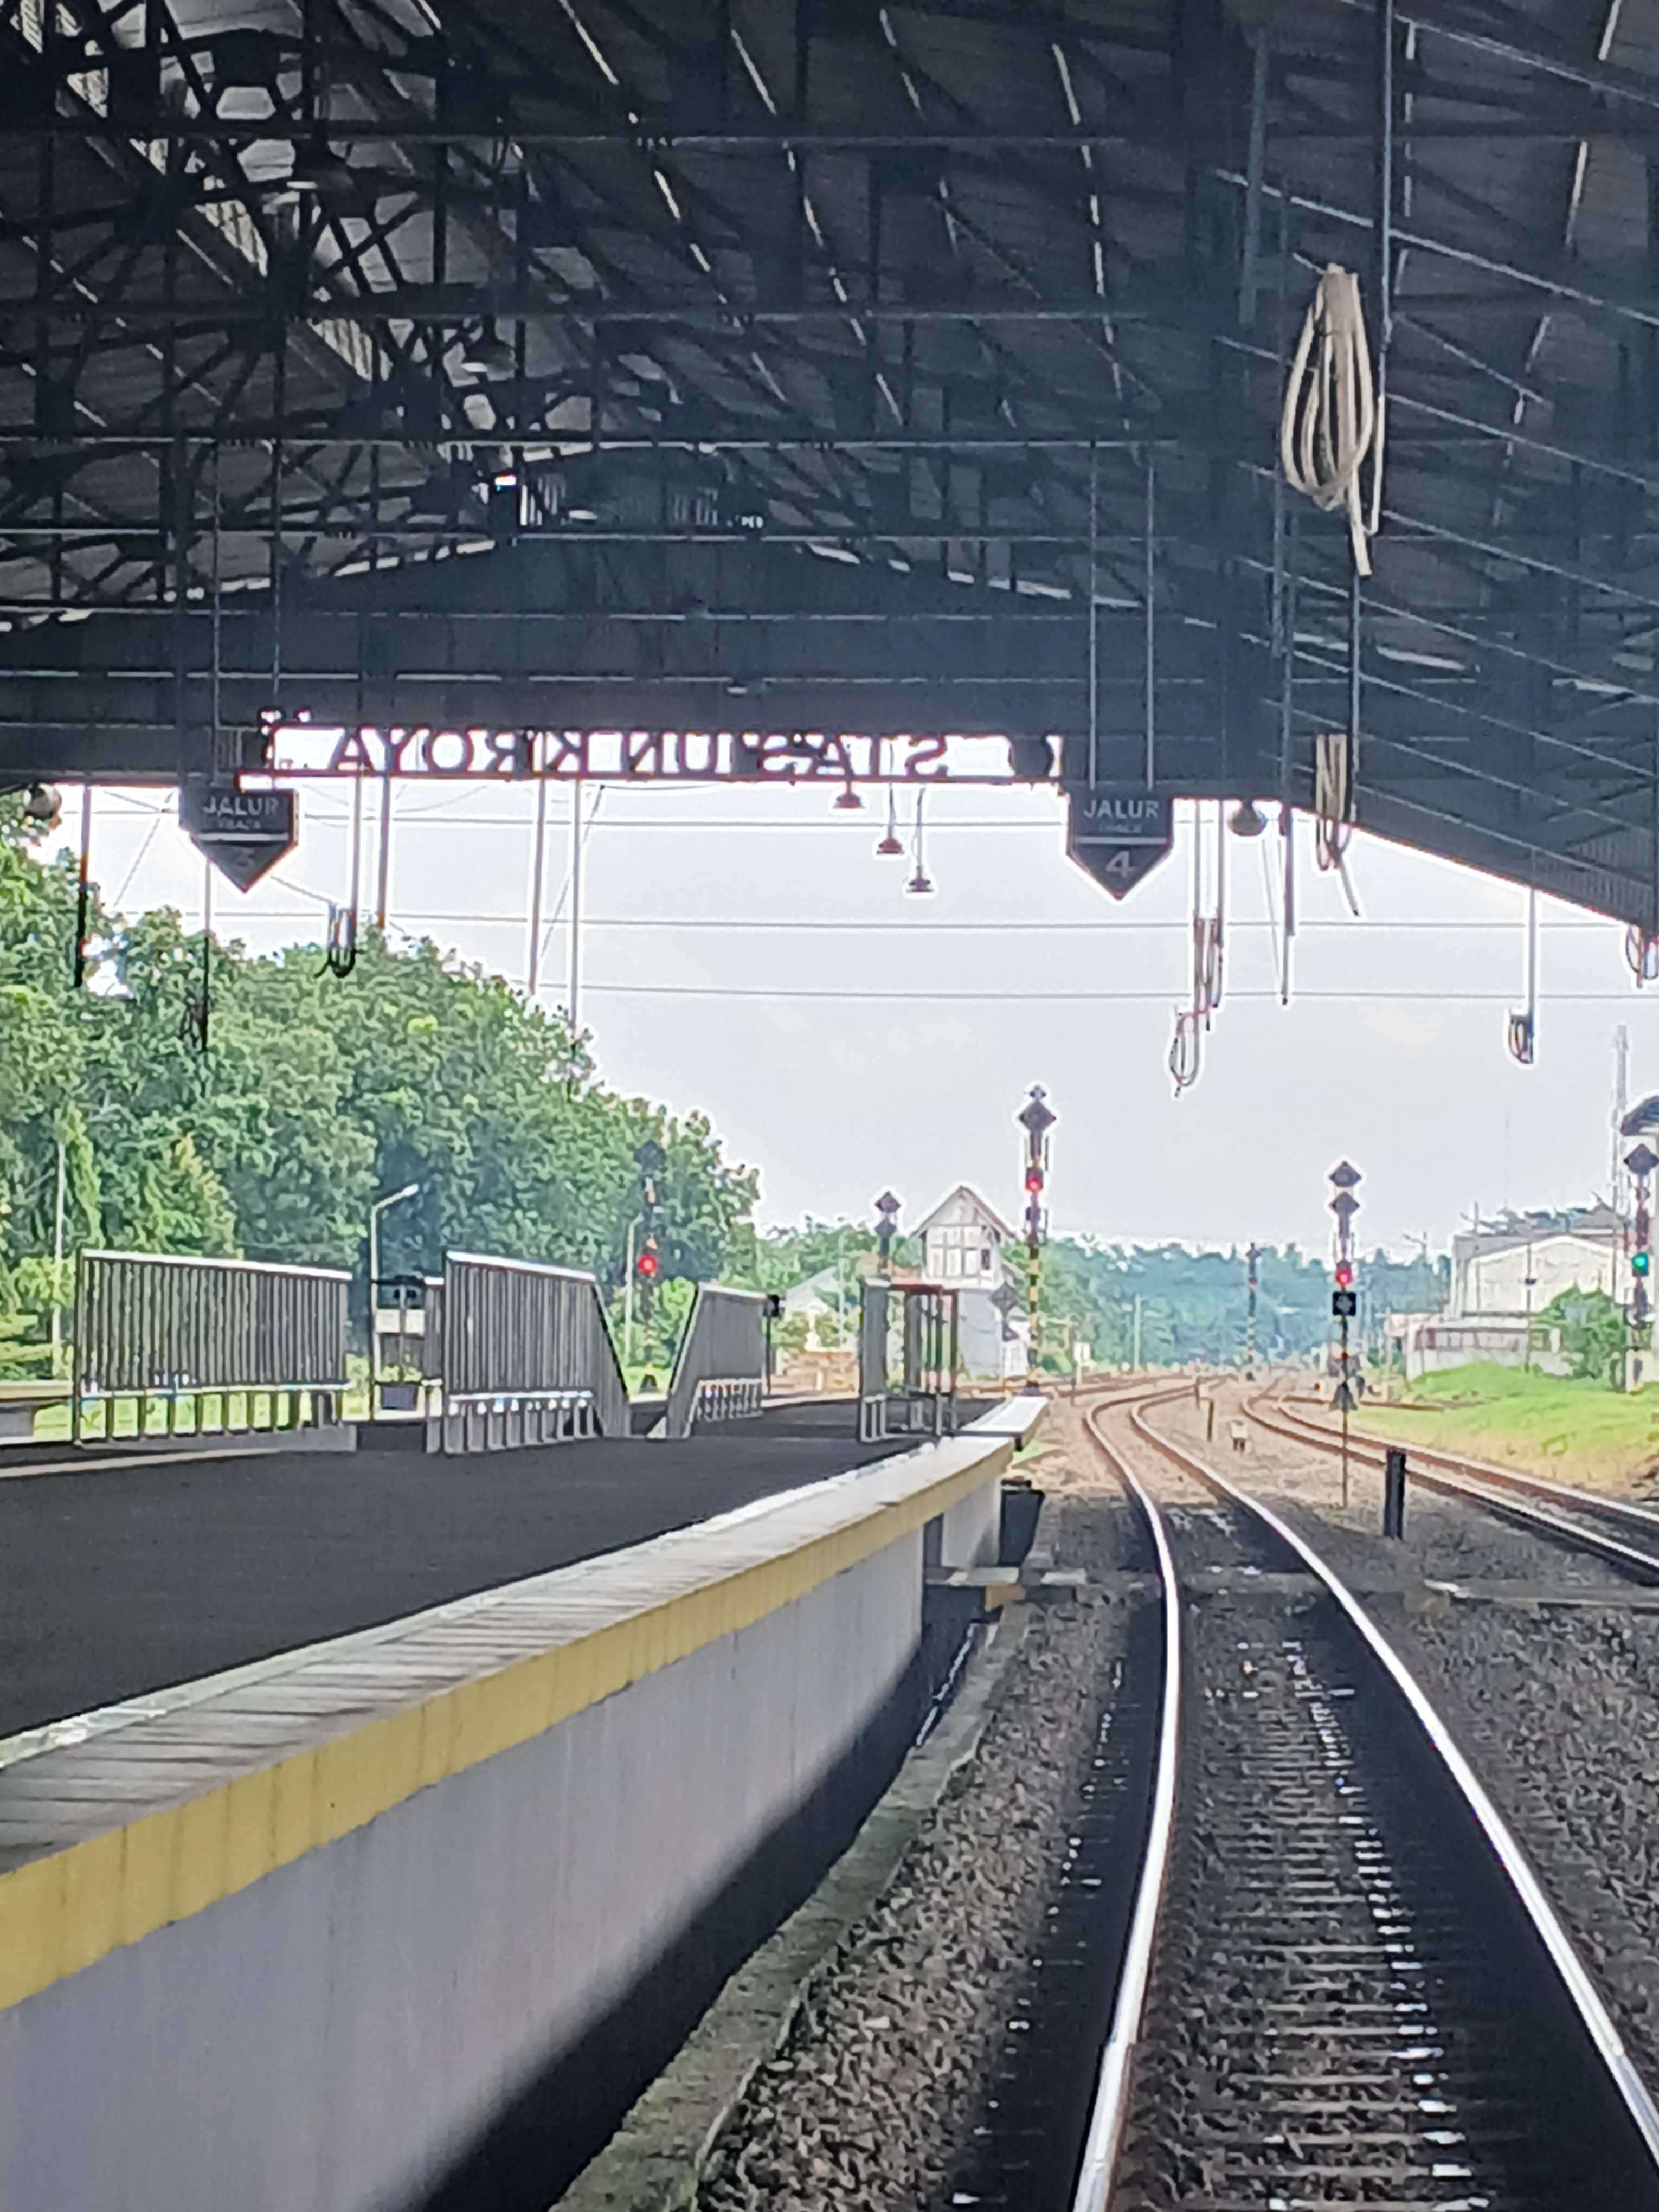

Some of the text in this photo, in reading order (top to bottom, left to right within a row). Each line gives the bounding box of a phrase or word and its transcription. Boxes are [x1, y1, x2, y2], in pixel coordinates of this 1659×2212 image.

[203, 796, 279, 816] JALUR
[1083, 799, 1159, 819] JALUR
[1106, 850, 1135, 878] 4
